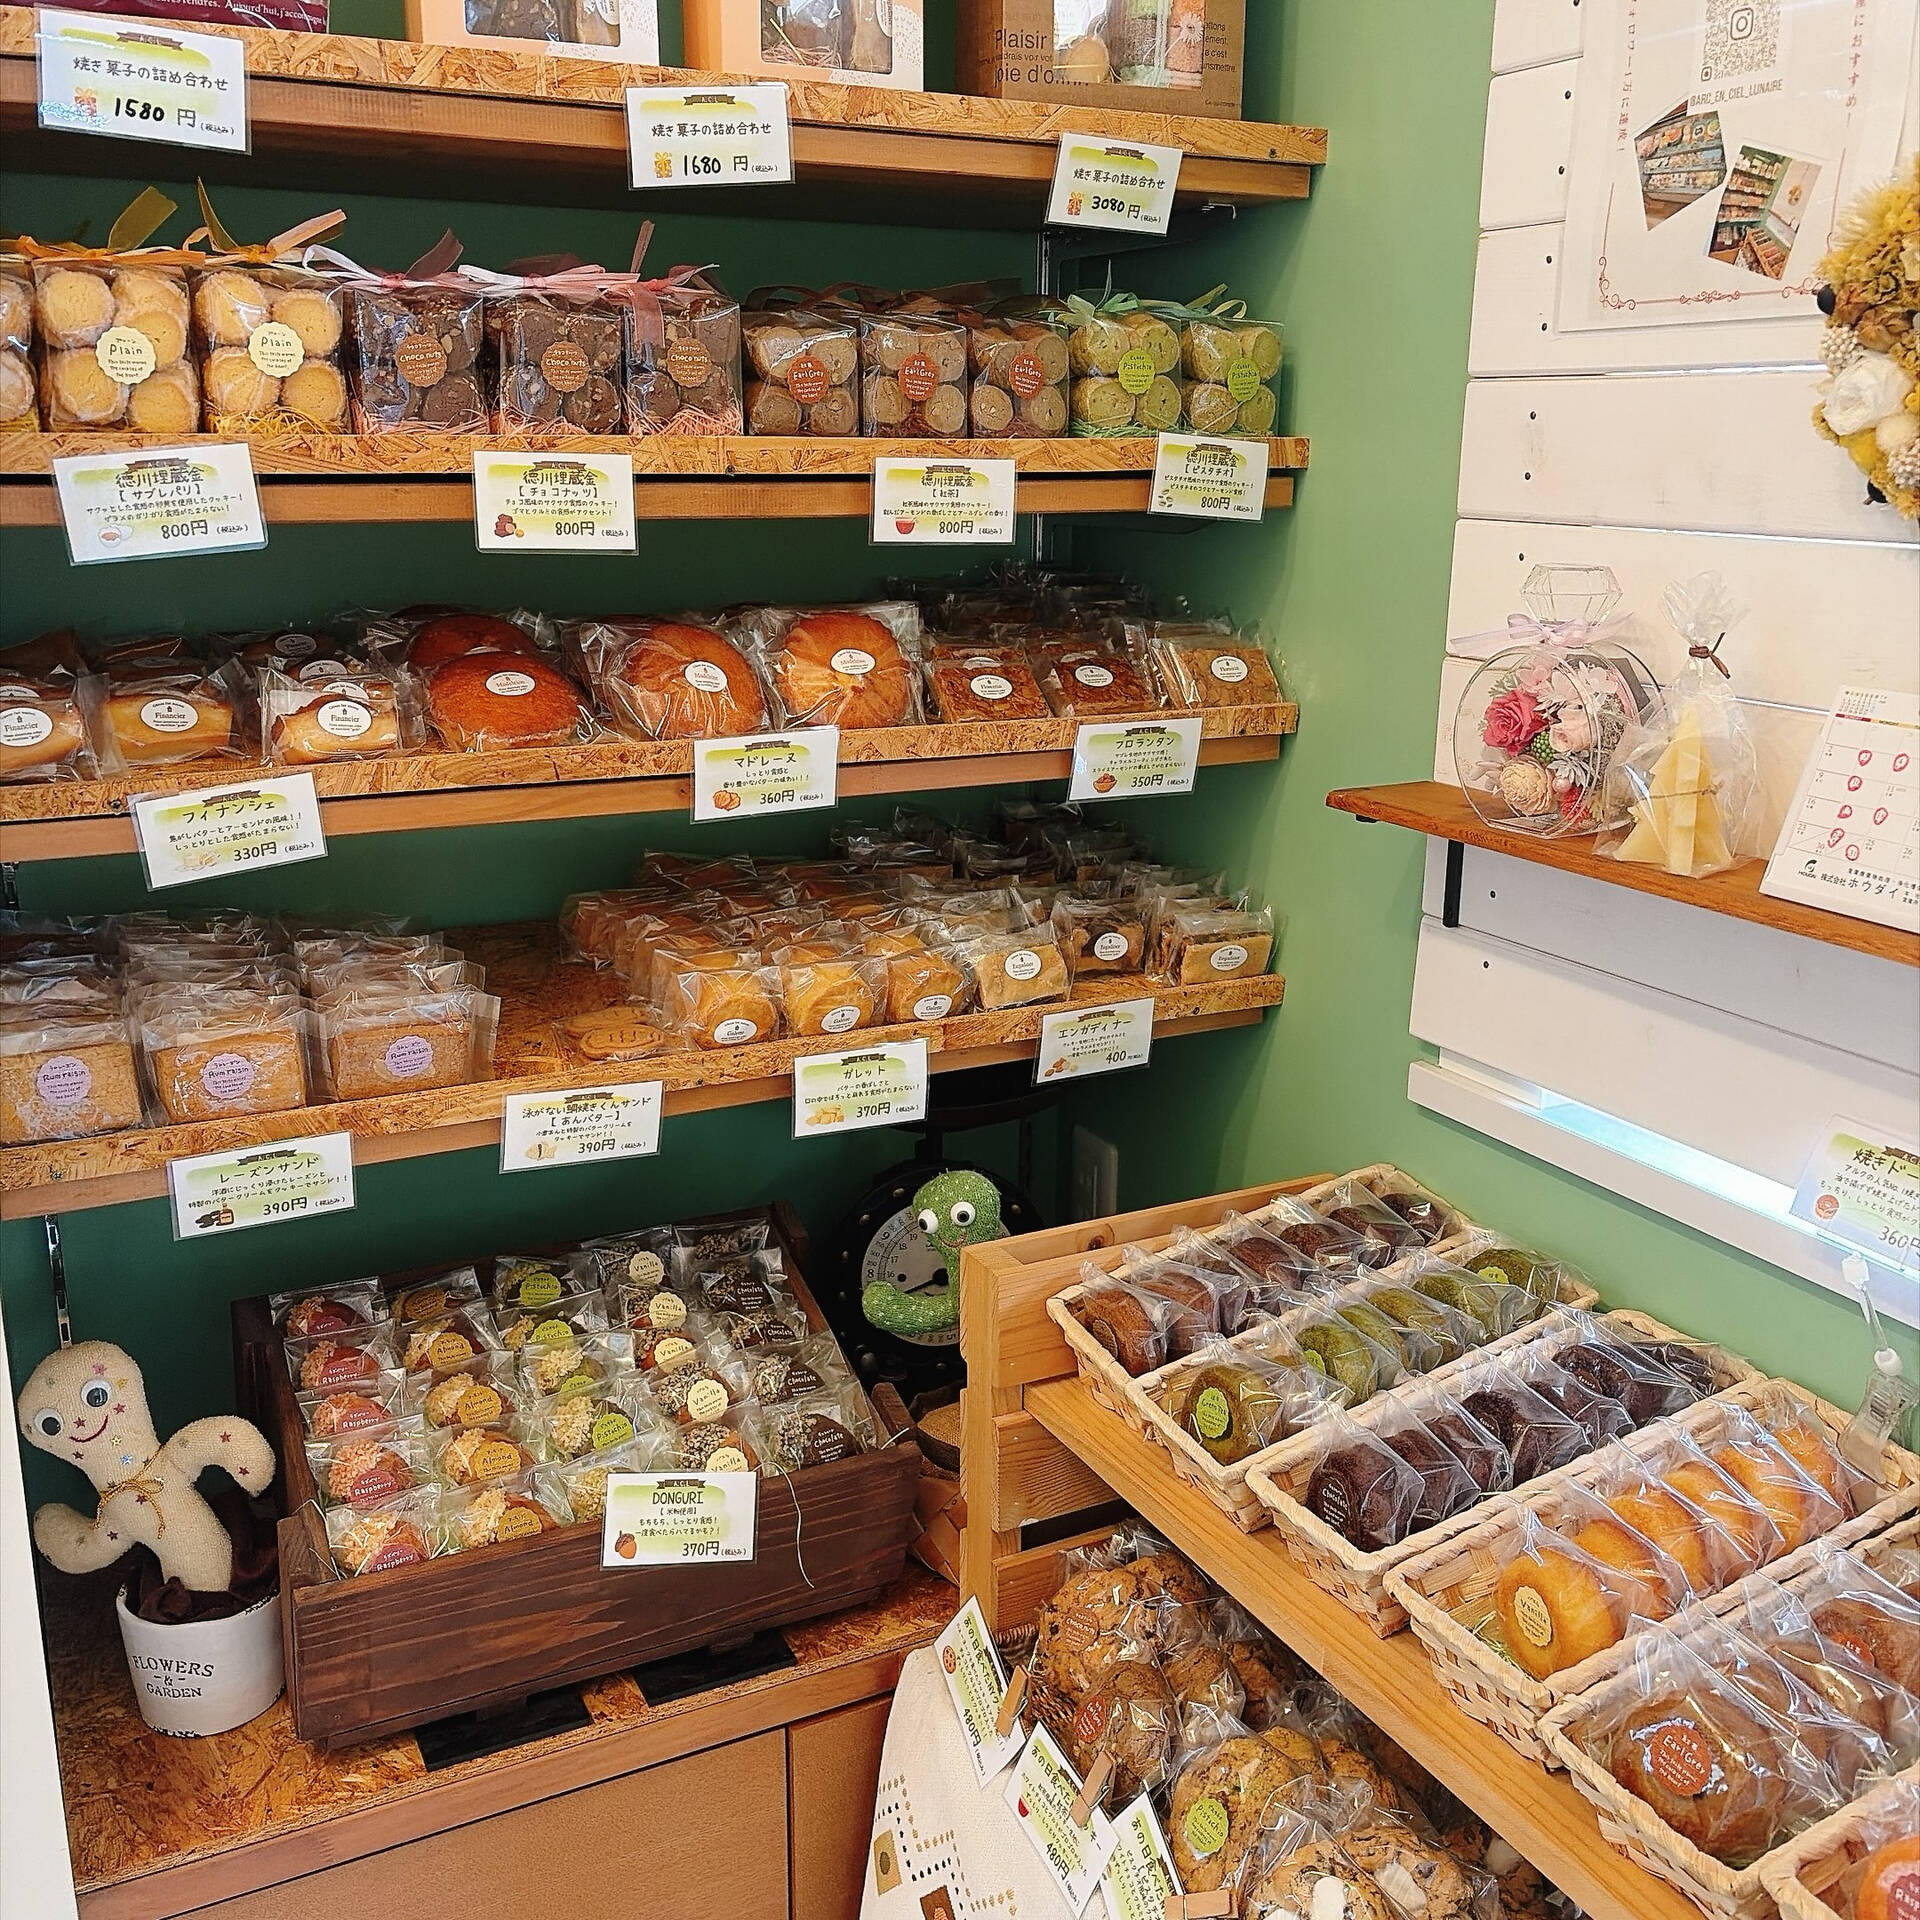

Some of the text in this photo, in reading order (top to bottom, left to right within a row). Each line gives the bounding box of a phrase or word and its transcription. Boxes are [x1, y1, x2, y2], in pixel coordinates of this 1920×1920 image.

[995, 28, 1048, 50] Plaisir
[72, 56, 229, 94] 焼き菓子の詰め合わせ
[114, 99, 165, 126] 1580
[177, 112, 197, 132] 円
[651, 122, 772, 138] 焼き菓子の詰め合わせ
[683, 153, 721, 177] 1680
[732, 154, 749, 172] 円
[1072, 168, 1166, 190] 焼き菓子の詰め合わせ
[1090, 195, 1125, 214] 3080
[1127, 204, 1141, 220] 円
[109, 343, 143, 356] Plain
[261, 337, 292, 348] Plain
[1186, 451, 1240, 468] 徳川埋蔵金
[115, 467, 204, 488] 徳川埋蔵金
[1184, 463, 1234, 478] 【ピスタチオ】
[522, 471, 598, 486] 徳川埋蔵金
[921, 475, 976, 488] 徳川埋蔵金
[518, 485, 599, 498] 【チョコナッツ】
[1200, 496, 1231, 510] 800円
[160, 519, 209, 540] 800円
[555, 521, 595, 536] 800円
[939, 520, 974, 535] 800円
[155, 712, 187, 720] Financier
[331, 714, 360, 723] Financier
[4, 722, 39, 733] Financier
[1115, 737, 1175, 750] フロランタン
[734, 752, 797, 768] マドレーヌ
[1130, 773, 1164, 788] 350円
[759, 789, 795, 806] 360円
[182, 799, 276, 824] フィナンシェ
[233, 841, 277, 863] 330円
[1058, 1019, 1132, 1039] エンガディナー
[390, 1047, 429, 1060] Rum raisin
[1105, 1050, 1127, 1064] 400
[42, 1070, 86, 1083] Rum raisin
[208, 1067, 249, 1079] Rum raisin
[843, 1065, 886, 1080] ガレット
[856, 1101, 891, 1118] 370円
[551, 1111, 620, 1128] 【あんバター】
[578, 1138, 616, 1154] 390円
[219, 1157, 320, 1184] レーズンサンド
[263, 1196, 308, 1216] 390円
[881, 1231, 890, 1241] 9
[909, 1233, 918, 1242] 19
[898, 1242, 908, 1250] 18
[890, 1255, 899, 1264] 17
[867, 1269, 875, 1278] 8
[886, 1270, 896, 1278] 16
[652, 1491, 704, 1505] DONGURI
[681, 1540, 720, 1558] 370円
[132, 1655, 215, 1678] FLOWERS
[146, 1682, 202, 1698] GARDEN
[962, 1707, 982, 1746] 480円
[1663, 1734, 1706, 1775] Earl Grey
[1045, 1842, 1070, 1880] 480円
